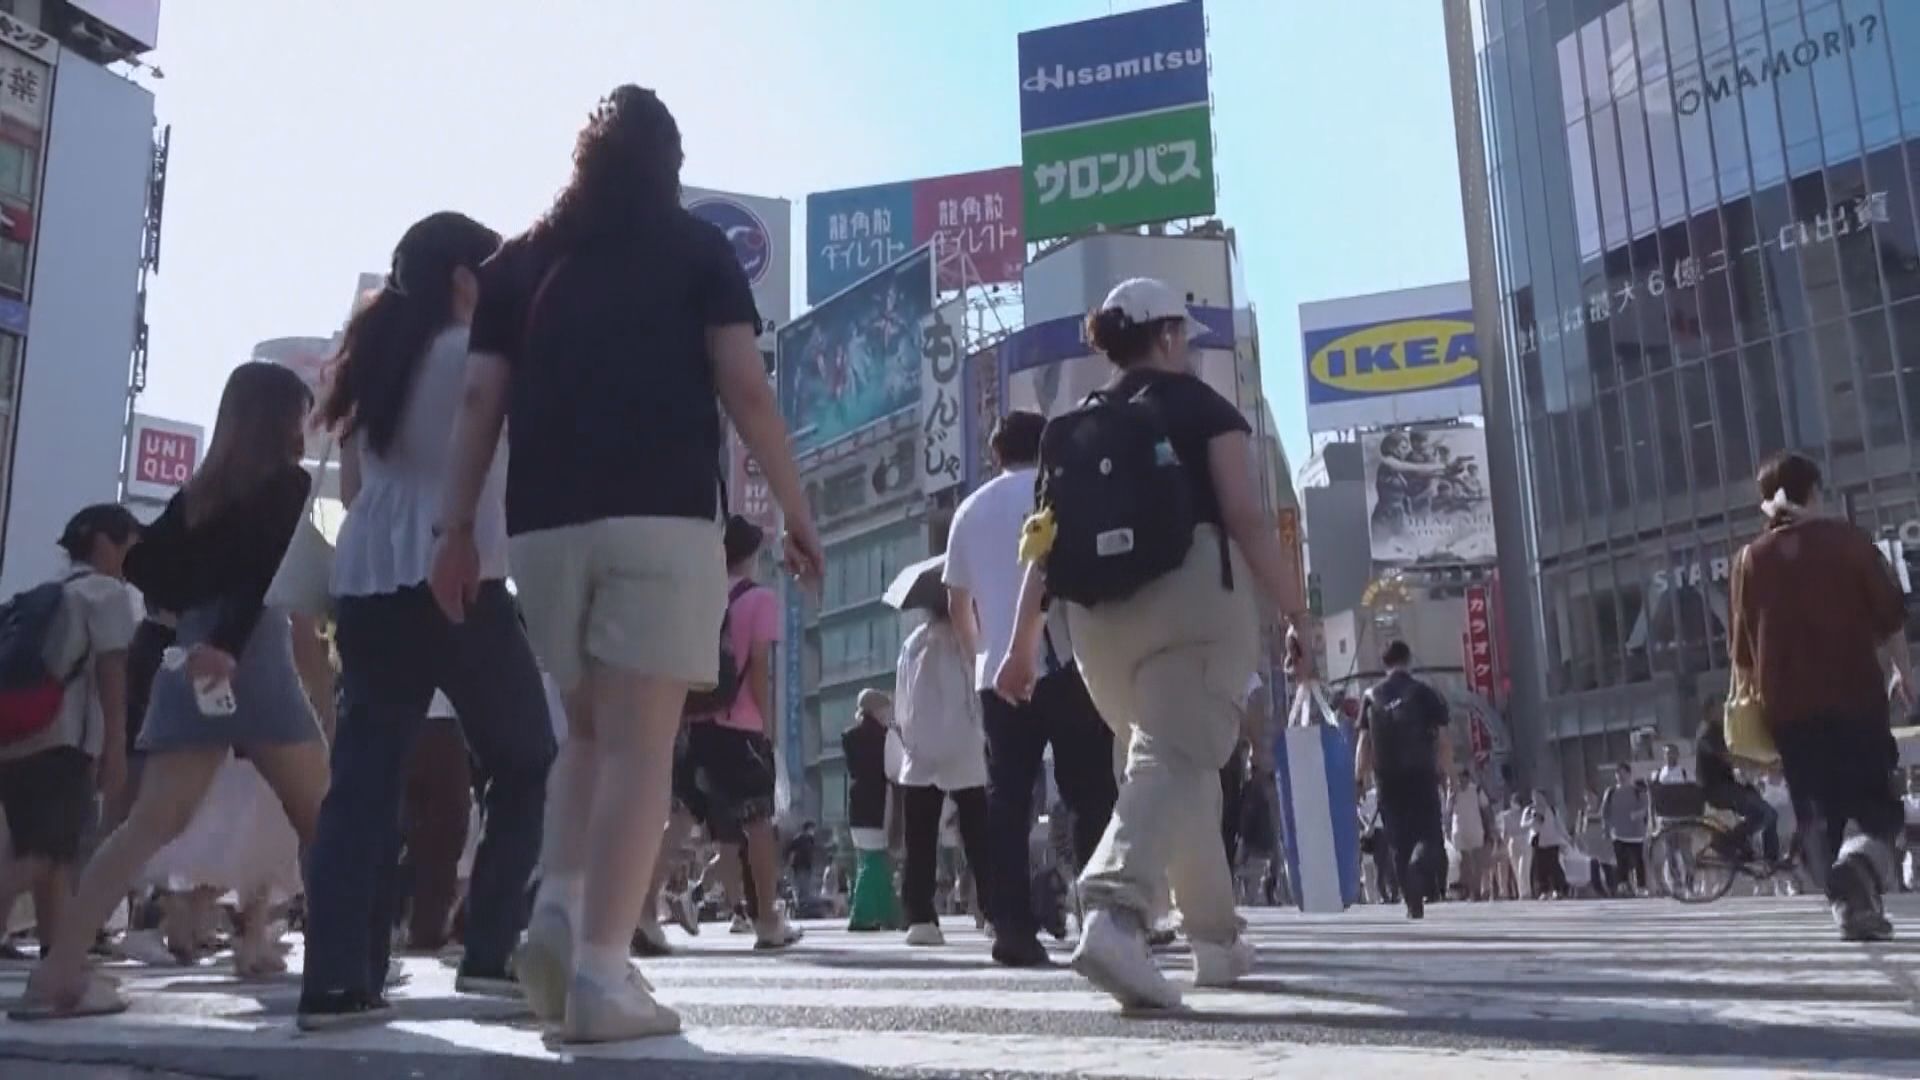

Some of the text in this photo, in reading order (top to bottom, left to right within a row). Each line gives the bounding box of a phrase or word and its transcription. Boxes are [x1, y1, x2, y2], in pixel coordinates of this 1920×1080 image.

[1022, 48, 1203, 92] Hisamitsu
[1678, 14, 1877, 115] OMAMORI?
[1034, 139, 1201, 204] サロンパス
[829, 207, 892, 241] 龍角散
[938, 192, 1004, 226] 龍角散
[821, 237, 904, 272] ダイレクト
[931, 223, 1018, 256] ダイレクト
[1327, 334, 1480, 378] IKEA
[923, 309, 962, 480] もんじゃ
[145, 434, 187, 460] UNI
[143, 458, 188, 481] QLO
